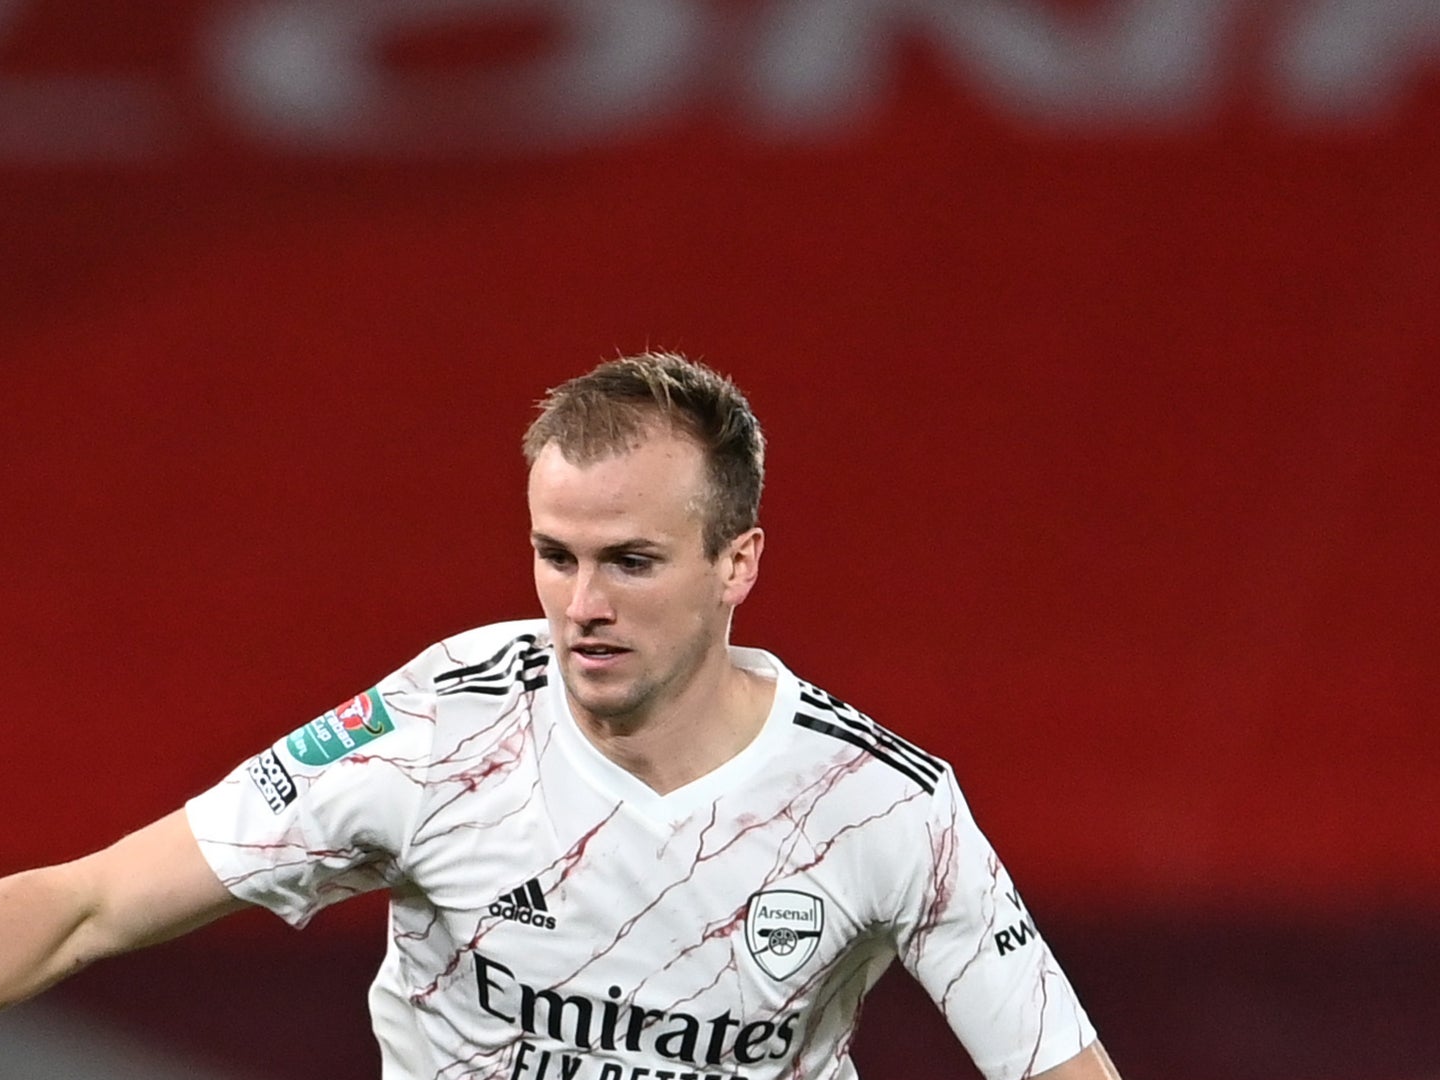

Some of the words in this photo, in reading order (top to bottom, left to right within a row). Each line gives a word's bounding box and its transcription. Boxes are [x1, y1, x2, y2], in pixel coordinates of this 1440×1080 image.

[488, 902, 557, 930] adidas
[758, 905, 813, 922] Arsenal
[473, 951, 800, 1066] Emirates
